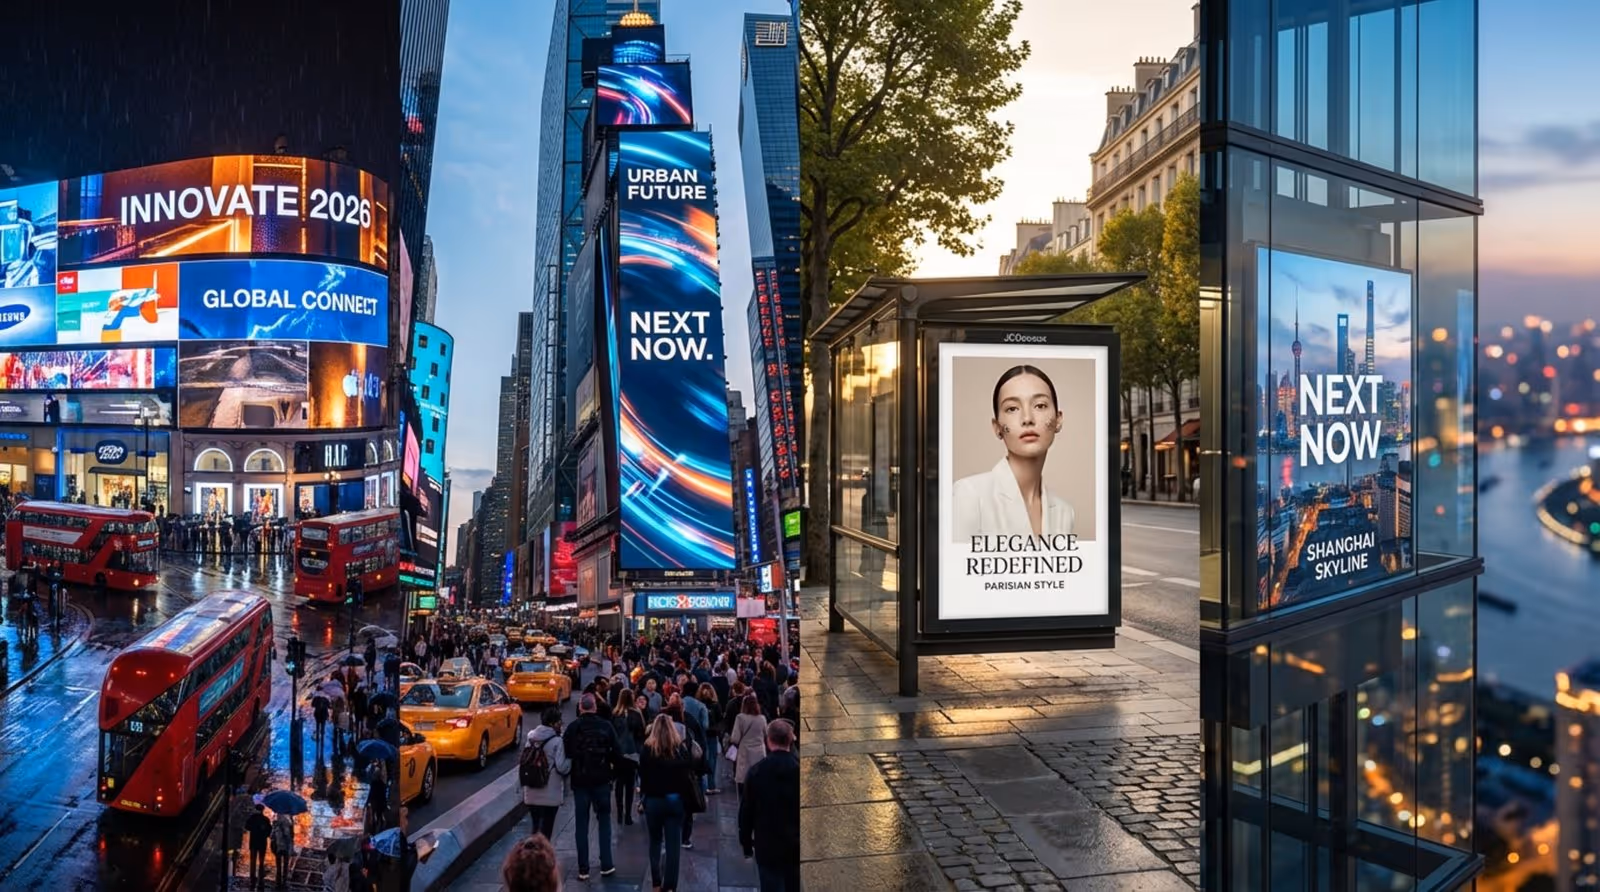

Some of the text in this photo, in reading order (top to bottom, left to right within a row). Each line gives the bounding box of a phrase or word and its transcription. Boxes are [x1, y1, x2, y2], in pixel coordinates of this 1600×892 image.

[628, 168, 698, 183] URBAN
[628, 185, 707, 200] FUTURE
[121, 185, 371, 228] INNOVATE 2026
[203, 289, 378, 316] GLOBAL CONNECT
[631, 311, 710, 334] NEXT
[631, 337, 713, 360] NOW.
[1300, 374, 1383, 416] NEXT
[1300, 420, 1381, 467] NOW
[970, 533, 1079, 553] ELEGANCE
[1306, 532, 1375, 562] SHANGHAI
[966, 555, 1083, 576] REDEFINED
[1315, 553, 1369, 581] SKYLINE
[984, 579, 1065, 591] PARISIAN STYLE
